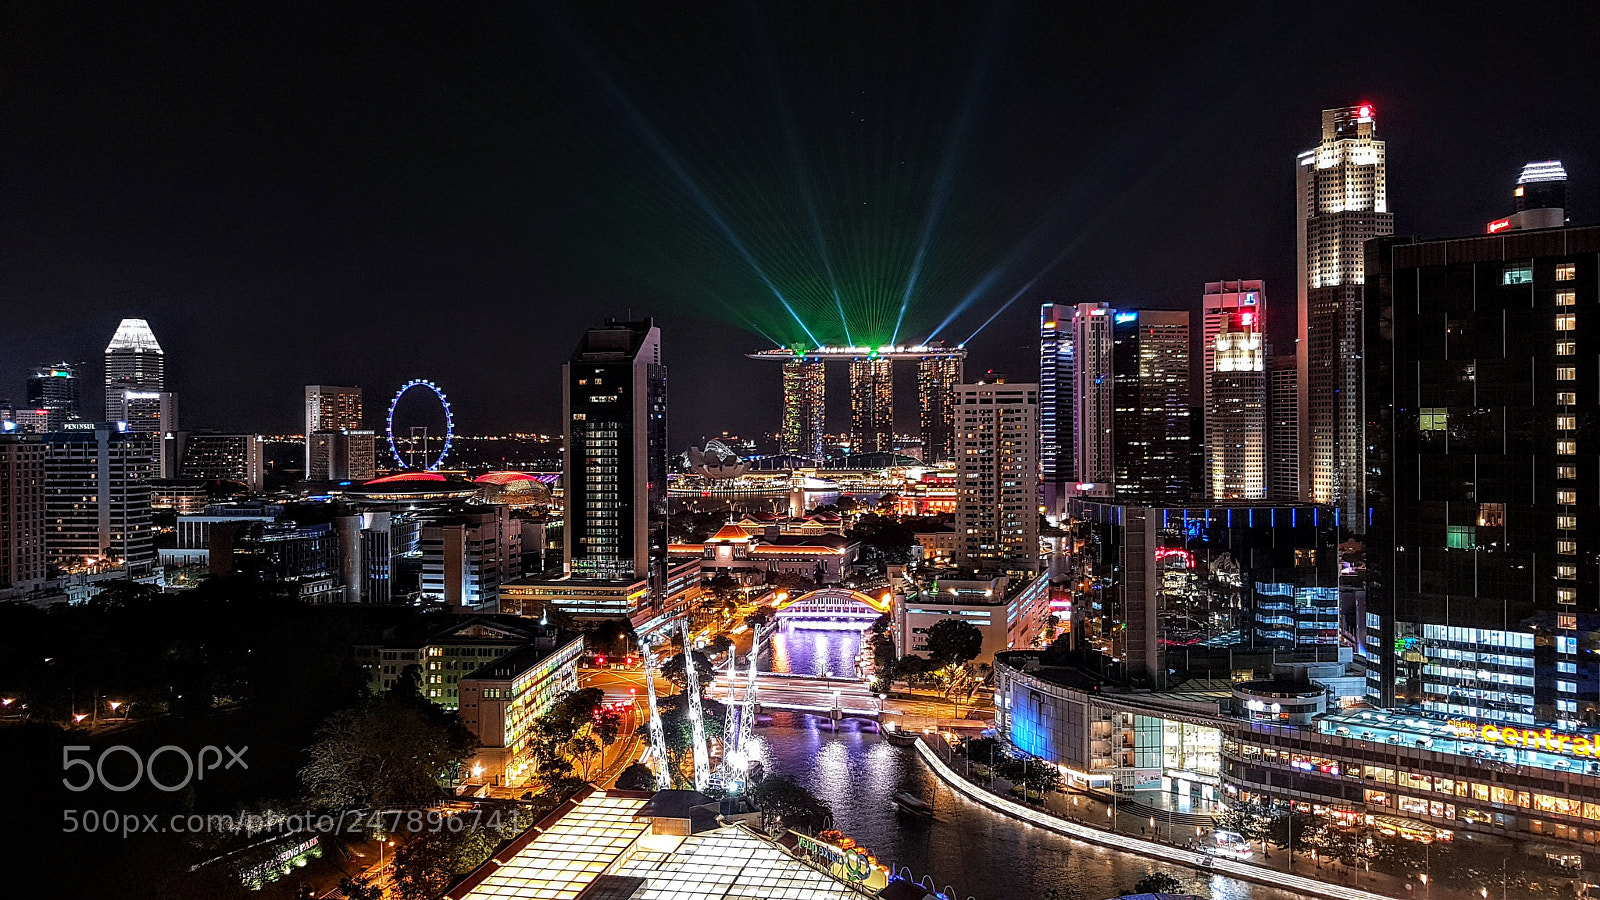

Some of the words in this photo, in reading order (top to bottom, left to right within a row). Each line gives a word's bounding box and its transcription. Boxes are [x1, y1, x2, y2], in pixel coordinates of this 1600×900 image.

[1447, 719, 1477, 730] clarke
[1481, 724, 1600, 758] central
[300, 835, 319, 852] PARK
